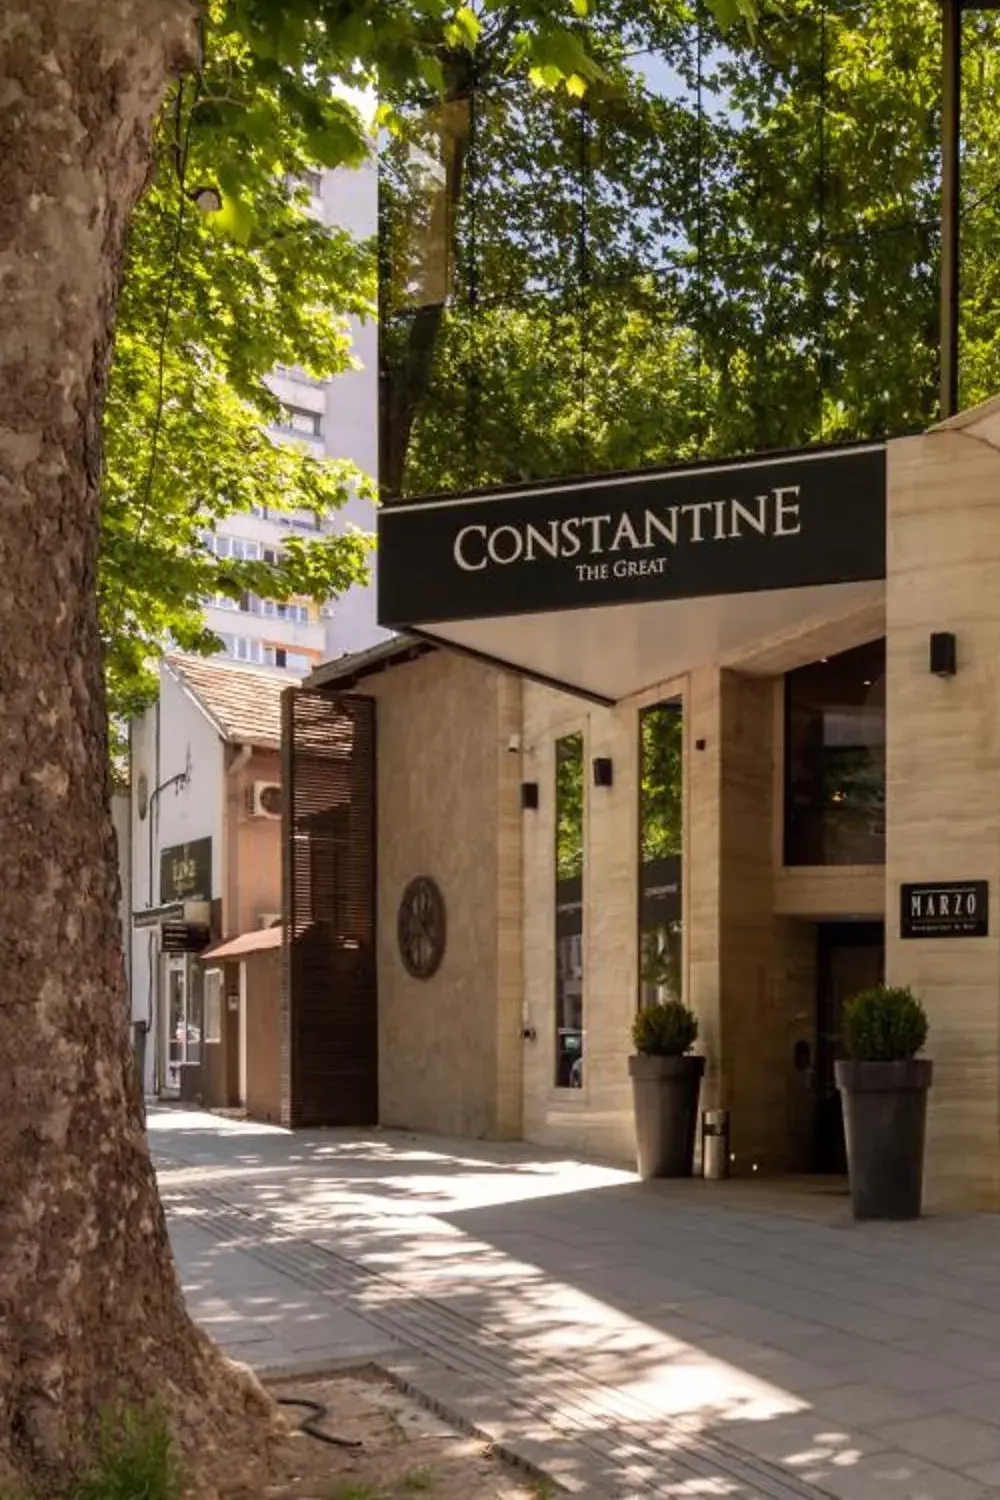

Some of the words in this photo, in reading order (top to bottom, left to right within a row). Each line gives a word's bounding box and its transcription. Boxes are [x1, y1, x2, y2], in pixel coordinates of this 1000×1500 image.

[453, 486, 801, 571] CONSTANTINE
[575, 563, 609, 581] THE
[613, 557, 668, 577] GREAT
[911, 893, 976, 917] MARZO
